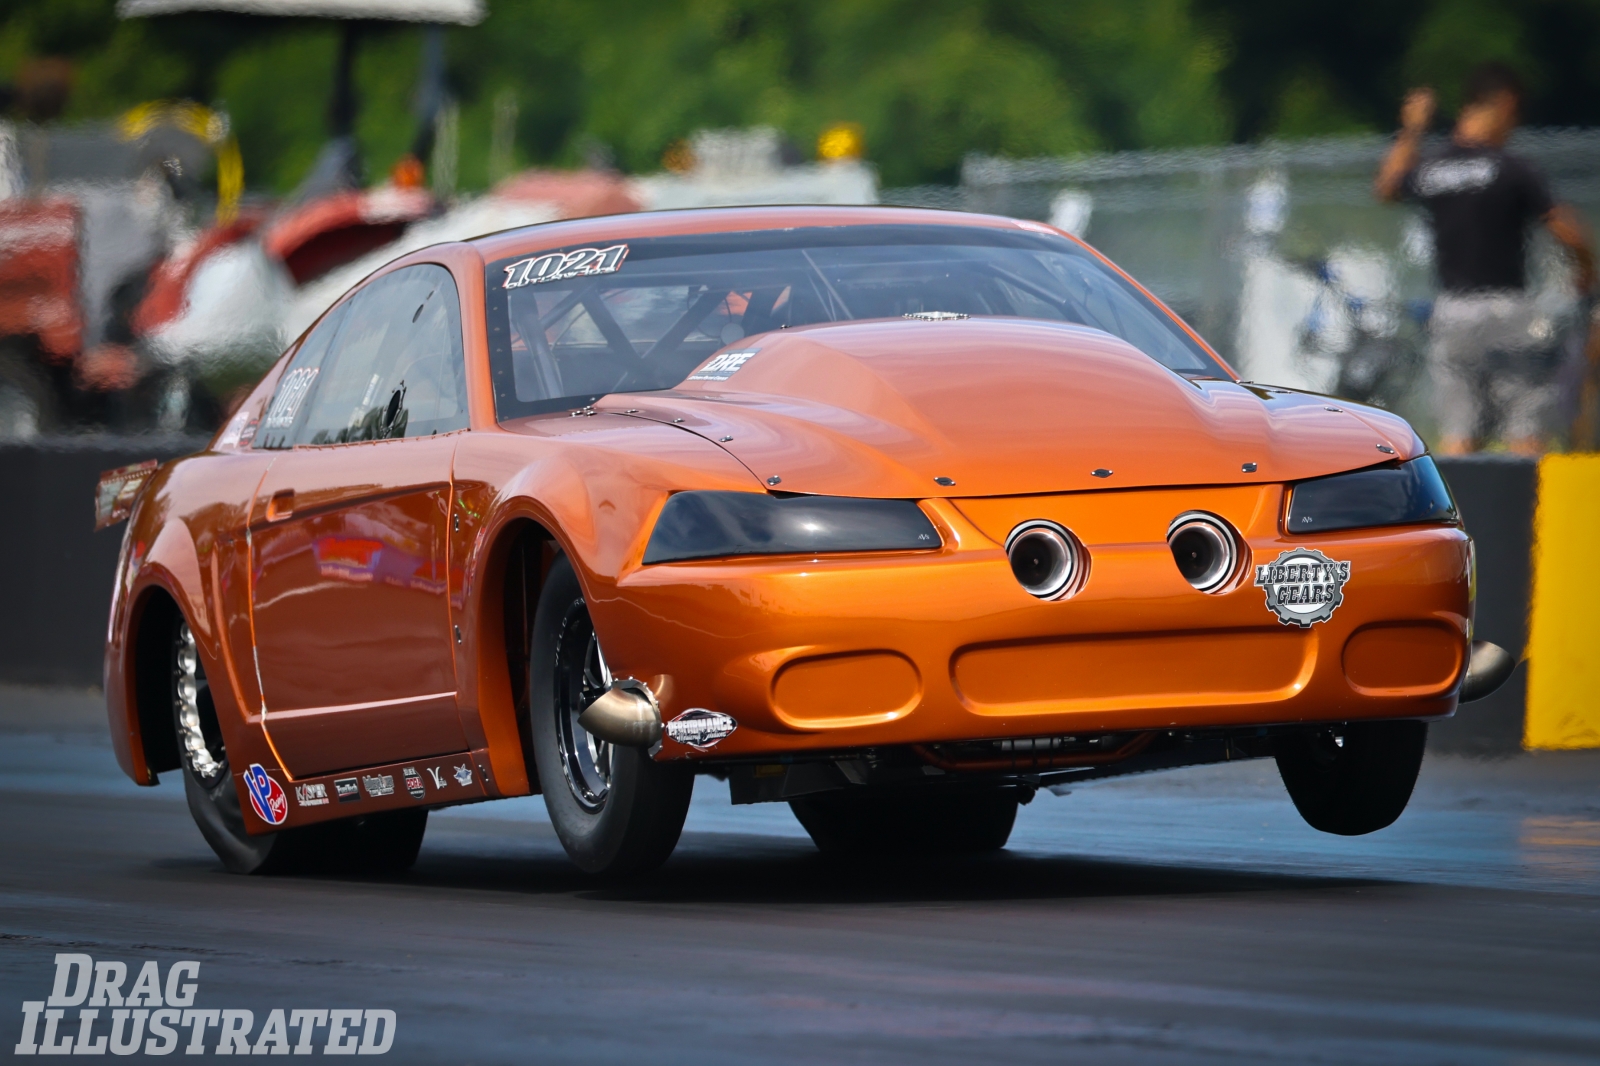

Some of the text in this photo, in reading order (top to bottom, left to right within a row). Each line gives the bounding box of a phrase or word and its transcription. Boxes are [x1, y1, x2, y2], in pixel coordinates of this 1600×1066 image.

[503, 244, 629, 288] 1021
[700, 352, 756, 372] DRE
[1255, 561, 1350, 586] LIBERTY'S
[1276, 583, 1335, 606] GEARS
